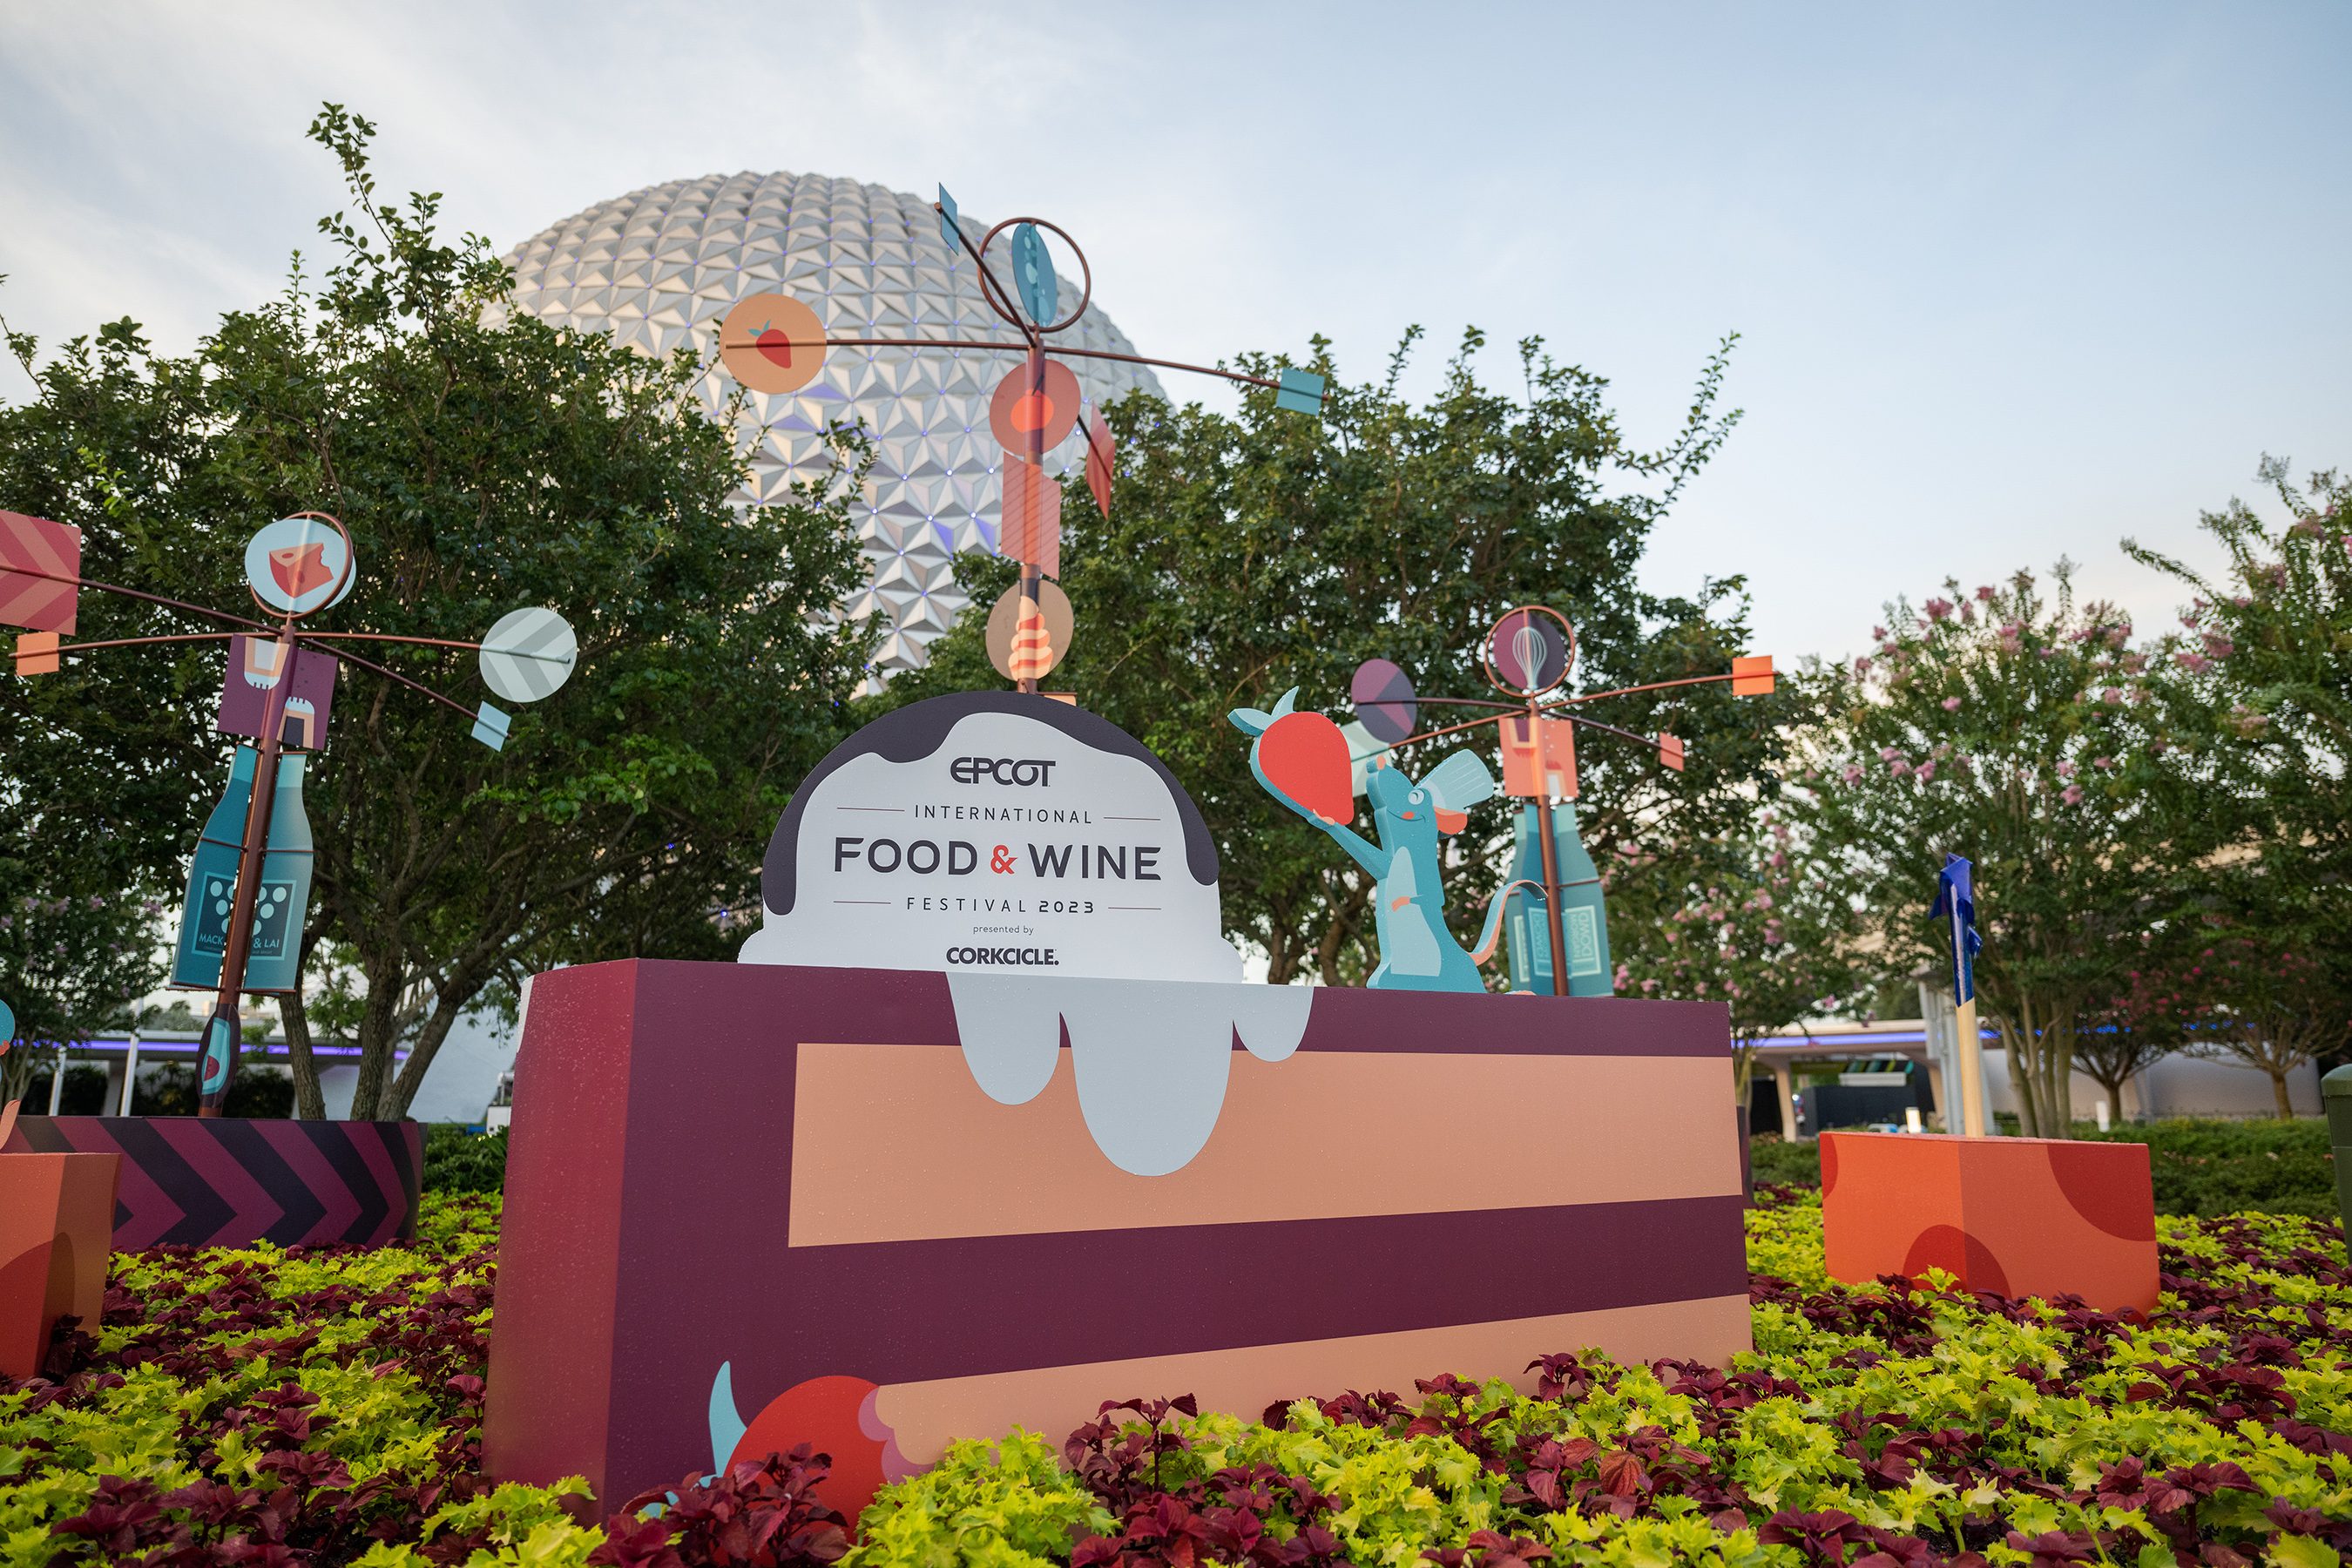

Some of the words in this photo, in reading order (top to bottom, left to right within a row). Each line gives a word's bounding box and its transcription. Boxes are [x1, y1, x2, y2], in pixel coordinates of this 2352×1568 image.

[950, 757, 1056, 787] EPCOT
[914, 804, 1092, 824] INTERNATIONAL
[834, 836, 977, 875] FOOD
[990, 844, 1018, 875] &
[1027, 842, 1162, 881] WINE
[907, 897, 1026, 913] FESTIVAL
[1038, 900, 1094, 914] 2023
[973, 925, 1020, 935] presented
[1023, 925, 1034, 936] by
[199, 933, 224, 946] MACK
[253, 937, 261, 949] &
[264, 938, 280, 949] LAI
